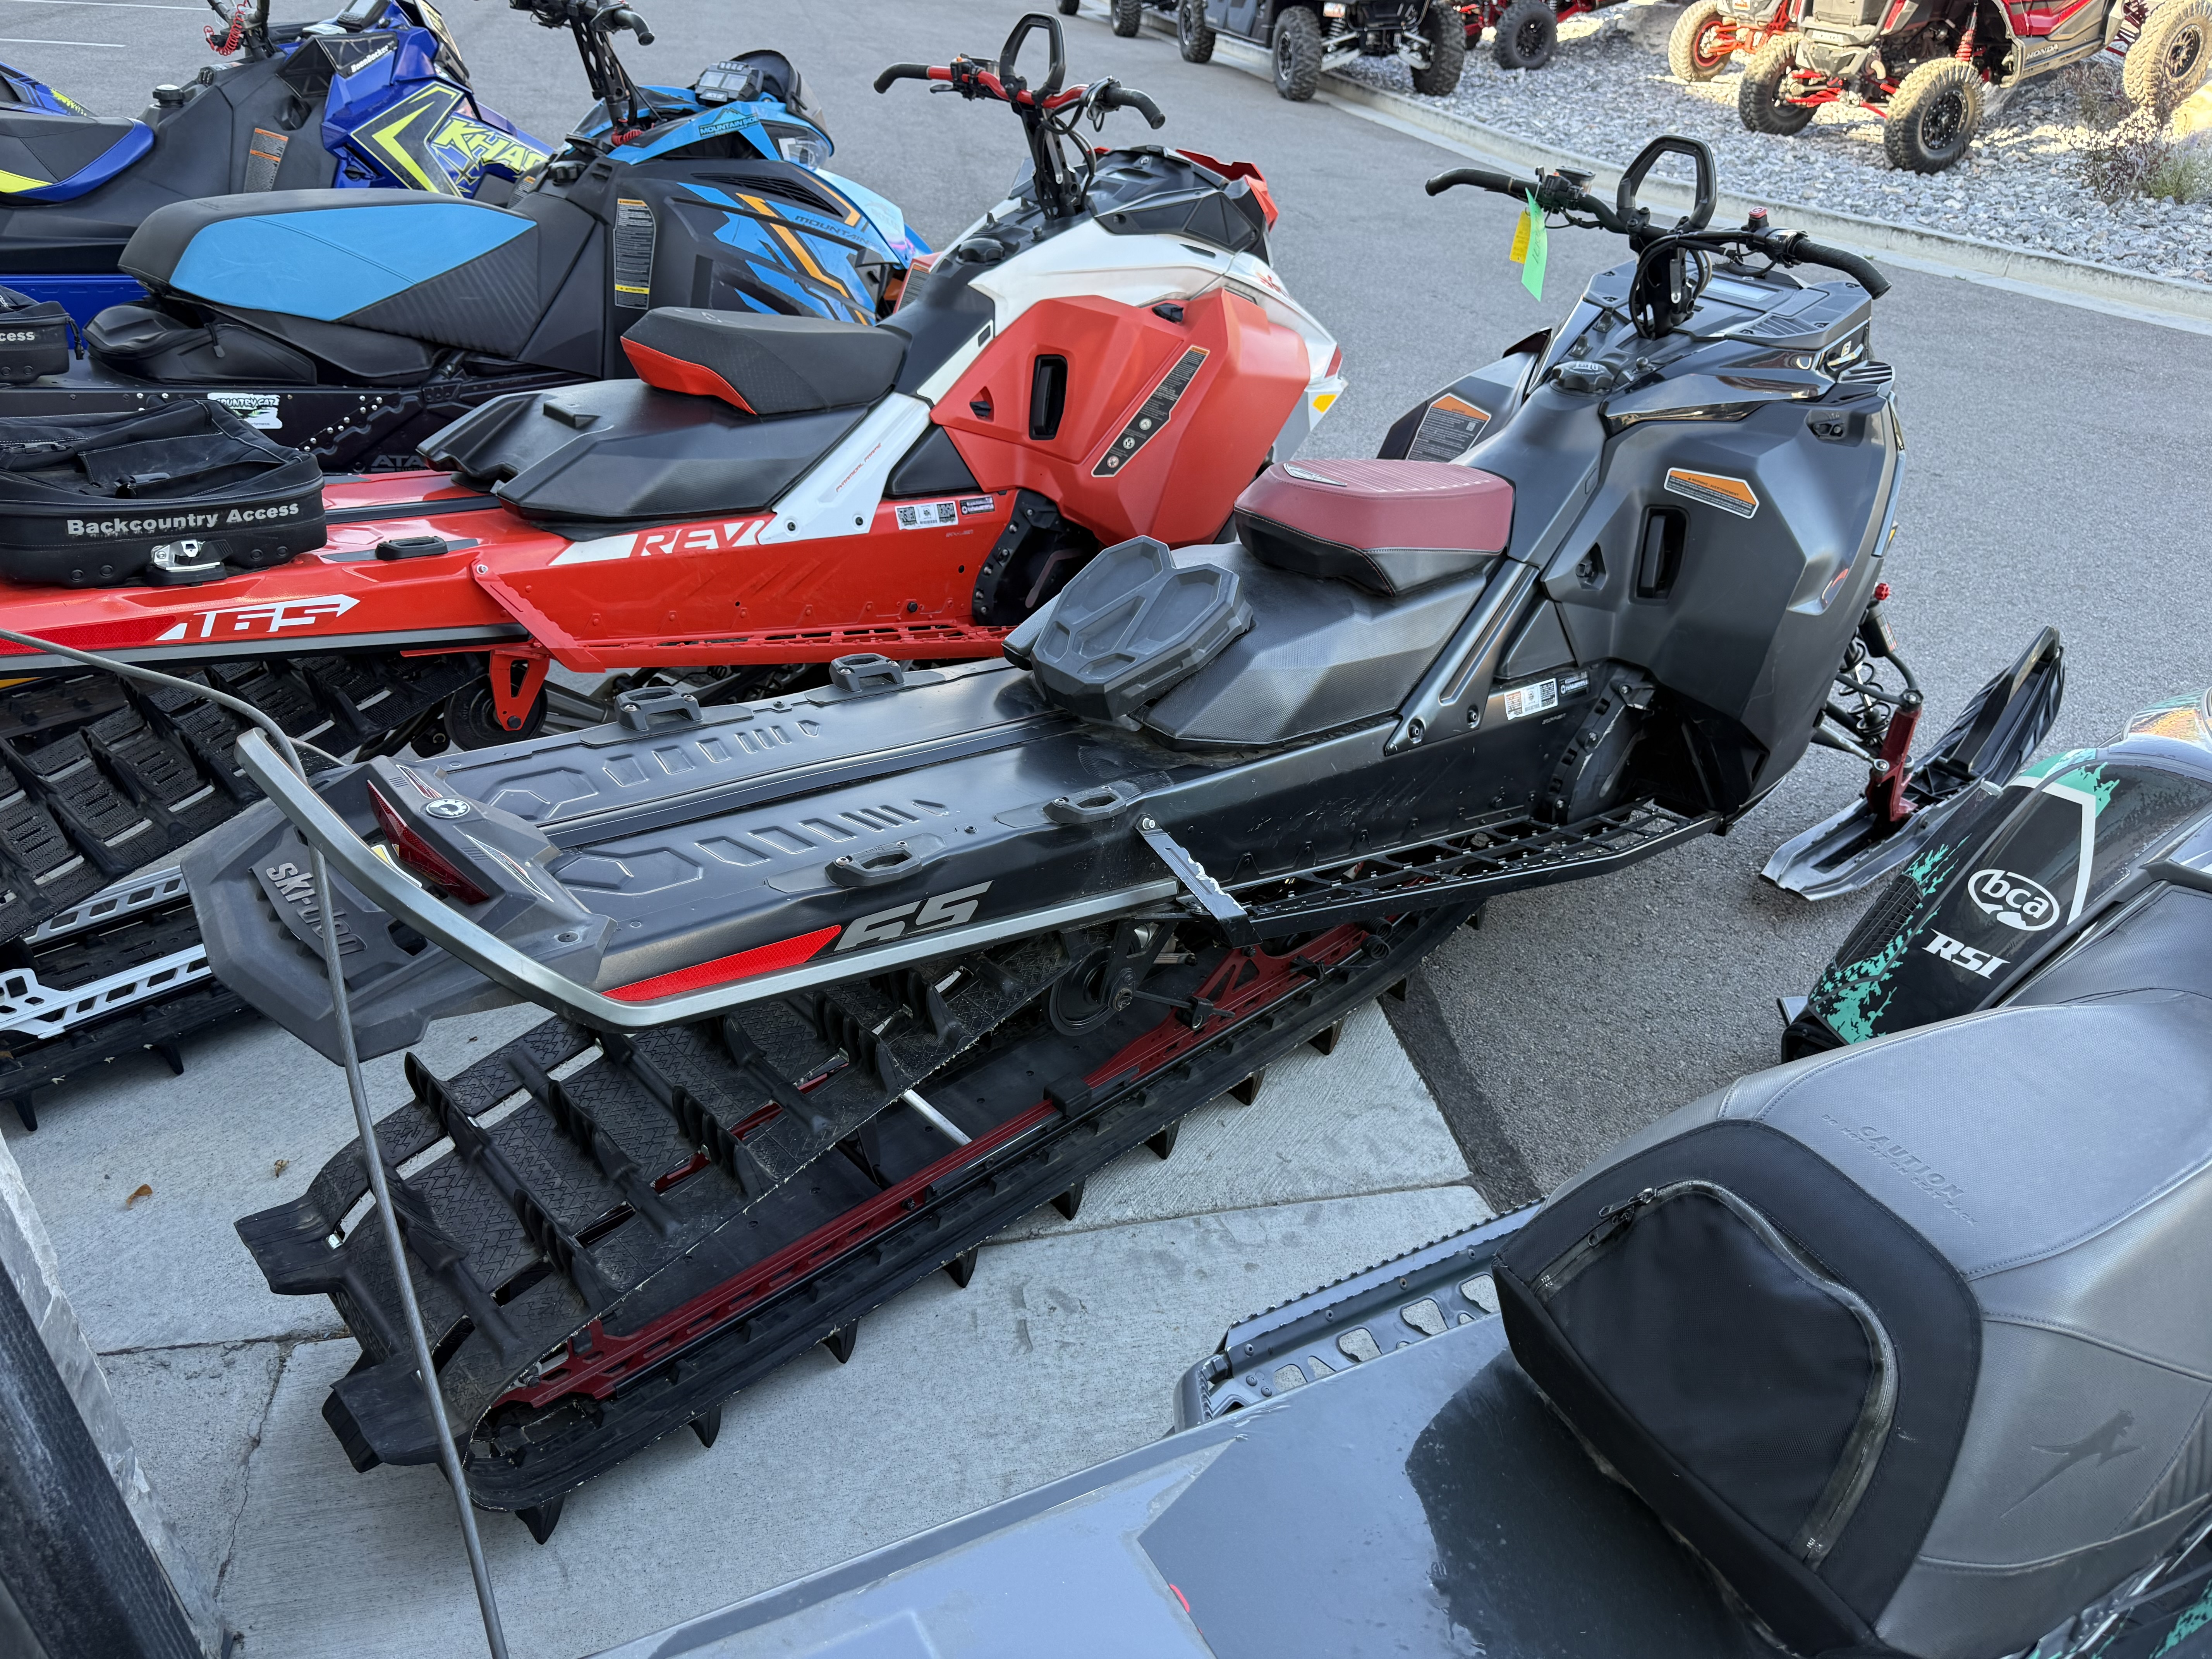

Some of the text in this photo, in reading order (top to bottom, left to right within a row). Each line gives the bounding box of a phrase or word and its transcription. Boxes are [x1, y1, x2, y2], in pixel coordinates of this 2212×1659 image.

[2026, 43, 2059, 60] HONDA
[700, 119, 742, 135] MOUNTAIN
[0, 332, 35, 342] cess
[371, 455, 426, 467] ATA
[1691, 477, 1708, 486] WARNING
[1710, 484, 1740, 497] AVERTISSEMENT
[67, 503, 299, 535] Backcountry Access
[1981, 871, 2049, 919] bca
[1921, 928, 2011, 980] RSI
[1821, 1114, 1978, 1226] DO NOT SIT ON SEAT BACK
[1859, 1126, 1965, 1199] CAUTION
